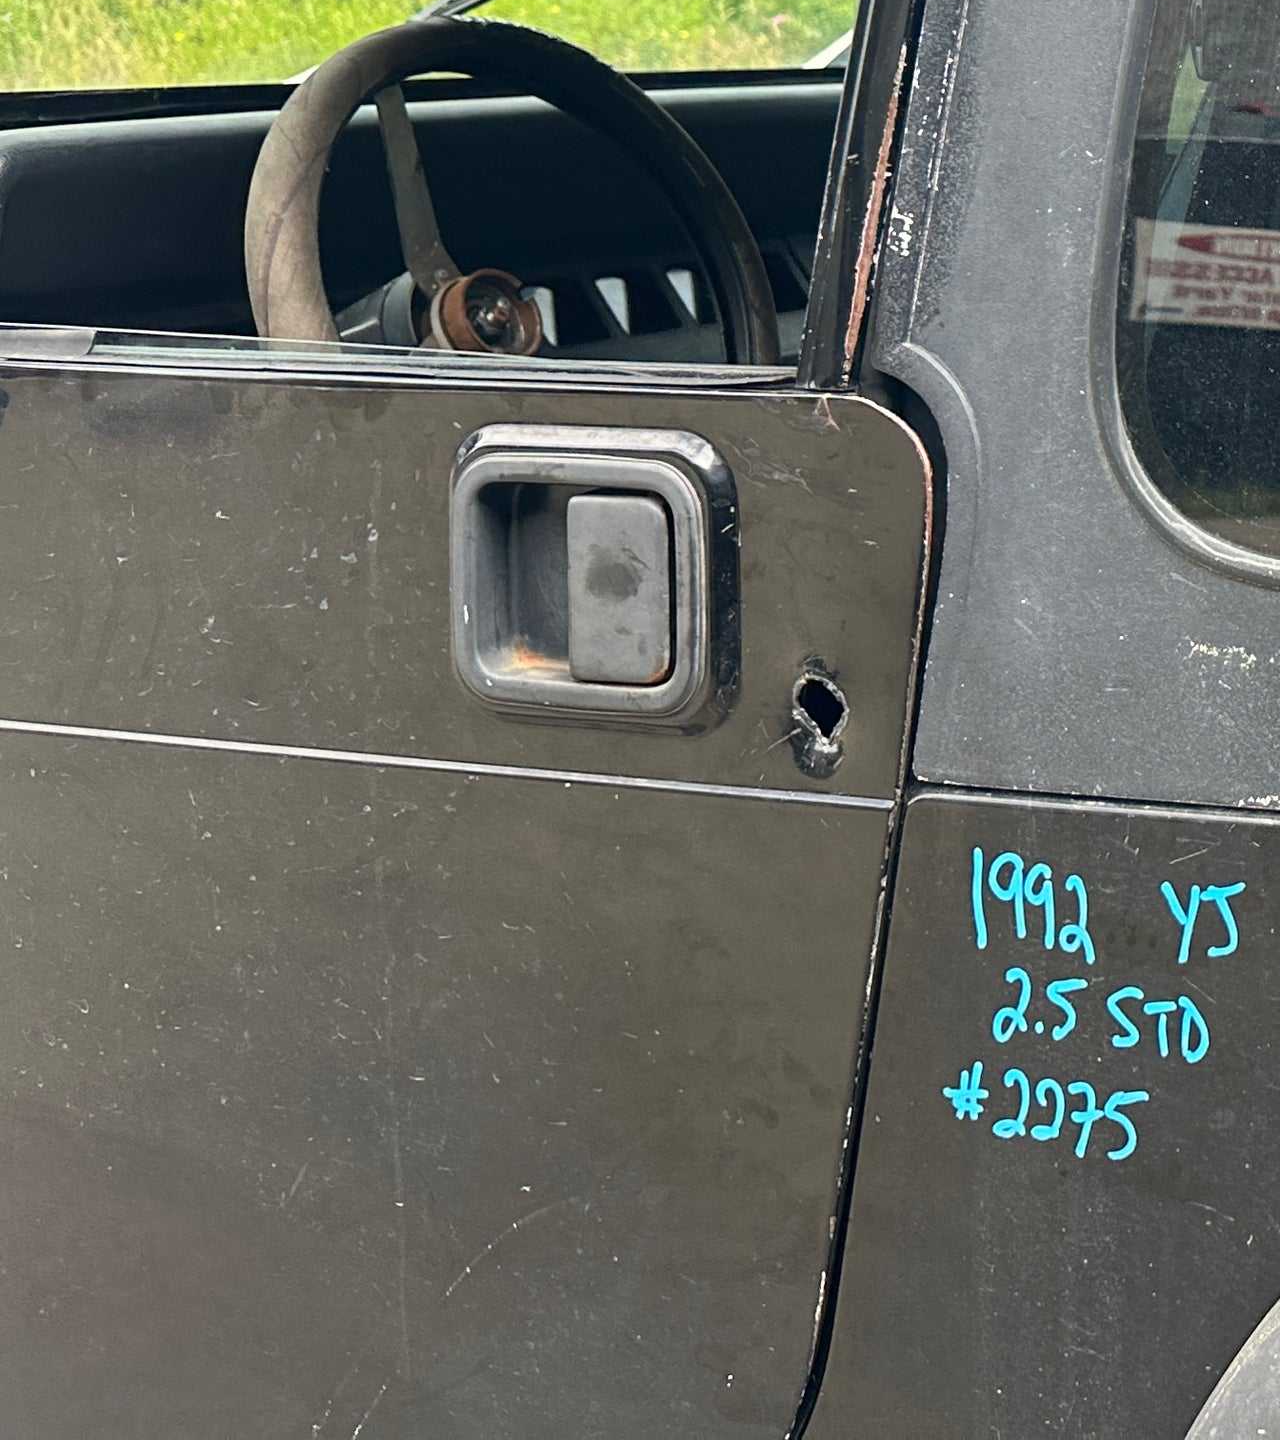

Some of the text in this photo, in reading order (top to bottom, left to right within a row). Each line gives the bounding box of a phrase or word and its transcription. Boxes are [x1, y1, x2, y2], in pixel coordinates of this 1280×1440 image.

[972, 846, 1247, 964] 1992 YJ
[992, 966, 1211, 1064] 2.5 STD
